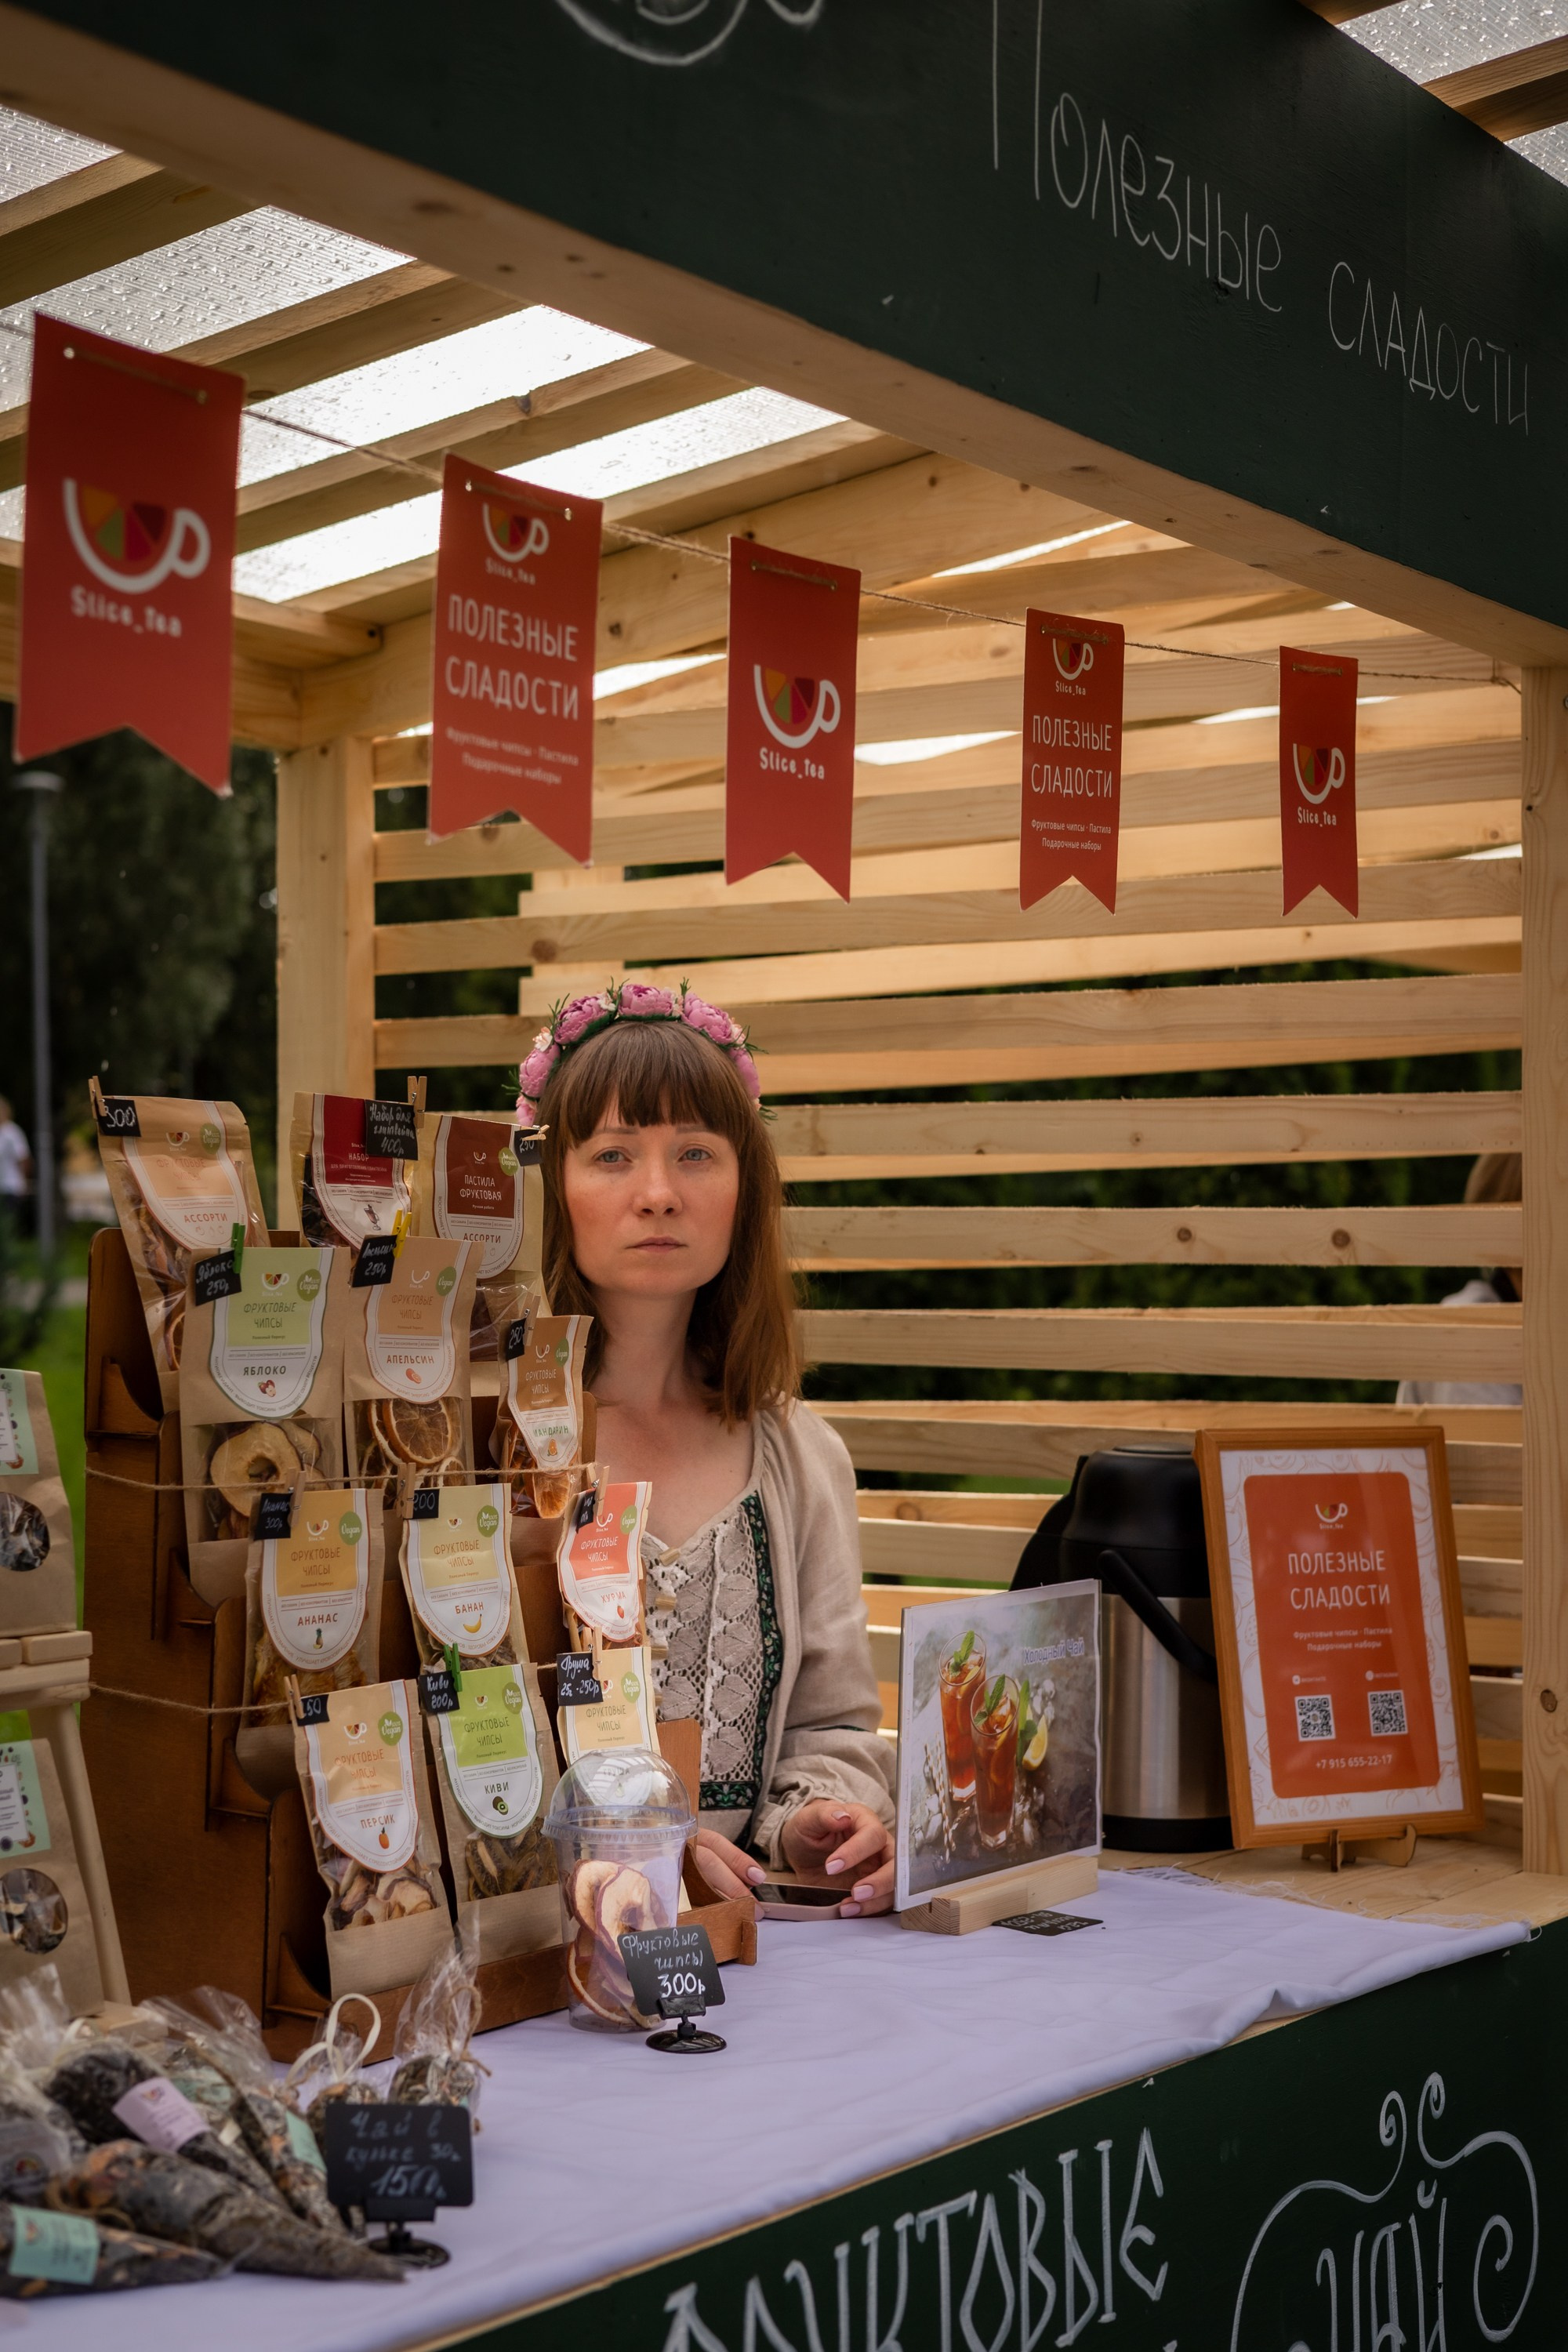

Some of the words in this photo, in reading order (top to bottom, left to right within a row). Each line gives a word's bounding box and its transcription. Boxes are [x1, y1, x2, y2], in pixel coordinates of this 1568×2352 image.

[448, 593, 579, 662] ПОЛЕЗНЫЕ
[445, 655, 579, 721] СЛАДОСТИ
[1055, 681, 1087, 696] Slice_Tea
[1033, 714, 1112, 752] ПОЛЕЗНЫЕ
[538, 746, 579, 767] Пастила
[759, 747, 825, 780] Slice_Tea
[461, 752, 523, 778] Подарочные
[524, 766, 562, 785] наборы
[1031, 763, 1112, 798] СЛАДОСТИ
[1298, 806, 1337, 828] Slice_Tea
[1031, 818, 1065, 833] Фруктовые
[1066, 822, 1085, 833] чипсы
[1089, 822, 1112, 834] Пастила
[1042, 837, 1080, 850] Подарочные
[1080, 840, 1102, 852] наборы
[369, 1102, 394, 1126] Набор
[396, 1106, 412, 1123] для
[202, 1134, 220, 1148] Vegan
[381, 1137, 405, 1156] 400р
[348, 1152, 369, 1162] НАБОР
[502, 1159, 517, 1170] Vegan
[464, 1174, 495, 1187] ПАСТИЛА
[460, 1189, 503, 1201] ФРУКТОВАЯ
[183, 1212, 228, 1223] АССОРТИ
[463, 1232, 501, 1243] АССОРТИ
[364, 1261, 387, 1279] 250р
[299, 1281, 318, 1294] Vegan
[438, 1276, 453, 1290] Vegan
[392, 1294, 434, 1305] ФРУКТОВЫЕ
[243, 1301, 297, 1313] ФРУКТОВЫЕ
[399, 1309, 422, 1319] ЧИПСЫ
[254, 1317, 283, 1328] ЧИПСЫ
[508, 1325, 523, 1350] 250
[387, 1355, 434, 1364] АПЕЛЬСИН
[243, 1366, 287, 1376] ЯБЛОКО
[525, 1369, 557, 1381] ФРУКТОВЫЕ
[532, 1384, 549, 1395] ЧИПСЫ
[479, 1518, 497, 1530] Vegan
[622, 1515, 636, 1528] Vegan
[341, 1523, 361, 1538] Vegan
[434, 1540, 480, 1555] ФРУКТОВЫЕ
[581, 1537, 619, 1550] ФРУКТОВЫЕ
[291, 1547, 341, 1561] ФРУКТОВЫЕ
[587, 1552, 608, 1563] ЧИПСЫ
[448, 1556, 474, 1568] ЧИПСЫ
[1288, 1550, 1386, 1575] ПОЛЕЗНЫЕ
[303, 1564, 330, 1576] ЧИПСЫ
[601, 1591, 626, 1603] ХУРМА
[1290, 1584, 1391, 1610] СЛАДОСТИ
[455, 1602, 484, 1614] БАНАН
[298, 1613, 338, 1627] АНАНАС
[1293, 1631, 1333, 1640] Фруктовые
[1363, 1627, 1393, 1635] Пастила
[1024, 1640, 1065, 1665] Холодный
[1066, 1637, 1084, 1657] Чай
[1306, 1642, 1352, 1652] Подарочные
[1354, 1639, 1382, 1650] наборы
[561, 1655, 590, 1679] Груша
[426, 1675, 449, 1692] Киви
[624, 1685, 640, 1697] Vegan
[303, 1697, 321, 1716] 50
[431, 1693, 453, 1709] 200р
[505, 1695, 521, 1708] Vegan
[586, 1704, 626, 1718] ФРУКТОВЫЕ
[464, 1716, 510, 1733] ФРУКТОВЫЕ
[597, 1721, 621, 1732] ЧИПСЫ
[382, 1726, 401, 1738] Vegan
[477, 1733, 503, 1747] ЧИПСЫ
[335, 1748, 384, 1766] ФРУКТОВЫЕ
[1329, 1758, 1346, 1769] 915
[485, 1781, 509, 1795] КИВИ
[361, 1814, 395, 1829] ПЕРСИК
[621, 1928, 699, 1959] Фруктовые
[654, 1950, 703, 1972] чипсы
[657, 1971, 706, 1998] 300р
